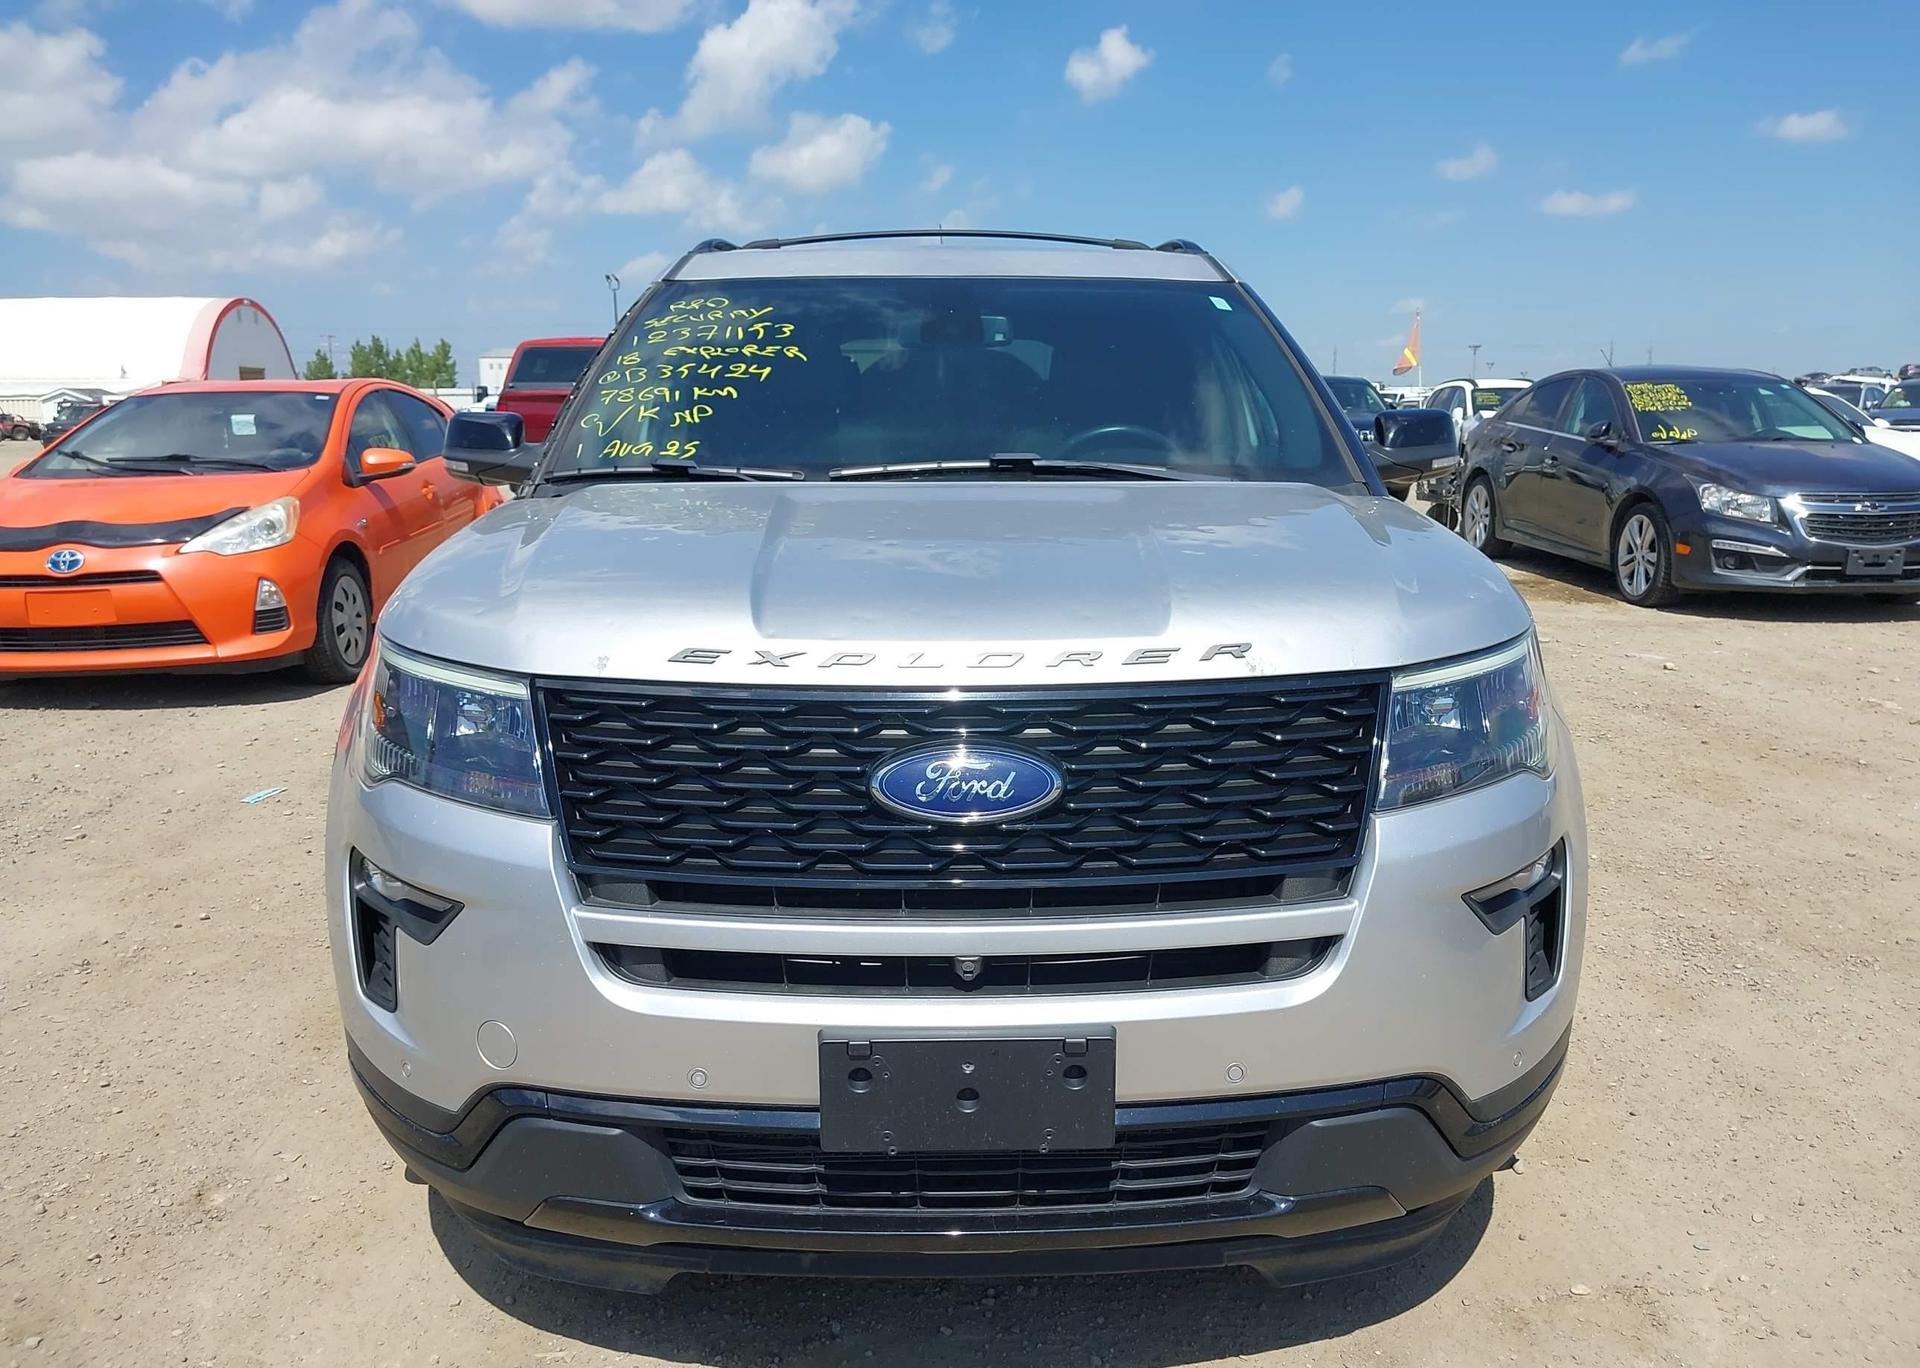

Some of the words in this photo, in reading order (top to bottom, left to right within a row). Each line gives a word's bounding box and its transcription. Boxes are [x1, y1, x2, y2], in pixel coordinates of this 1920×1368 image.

[600, 387, 680, 405] 78691
[667, 642, 1254, 669] EXPLORER
[915, 759, 1017, 803] Ford
